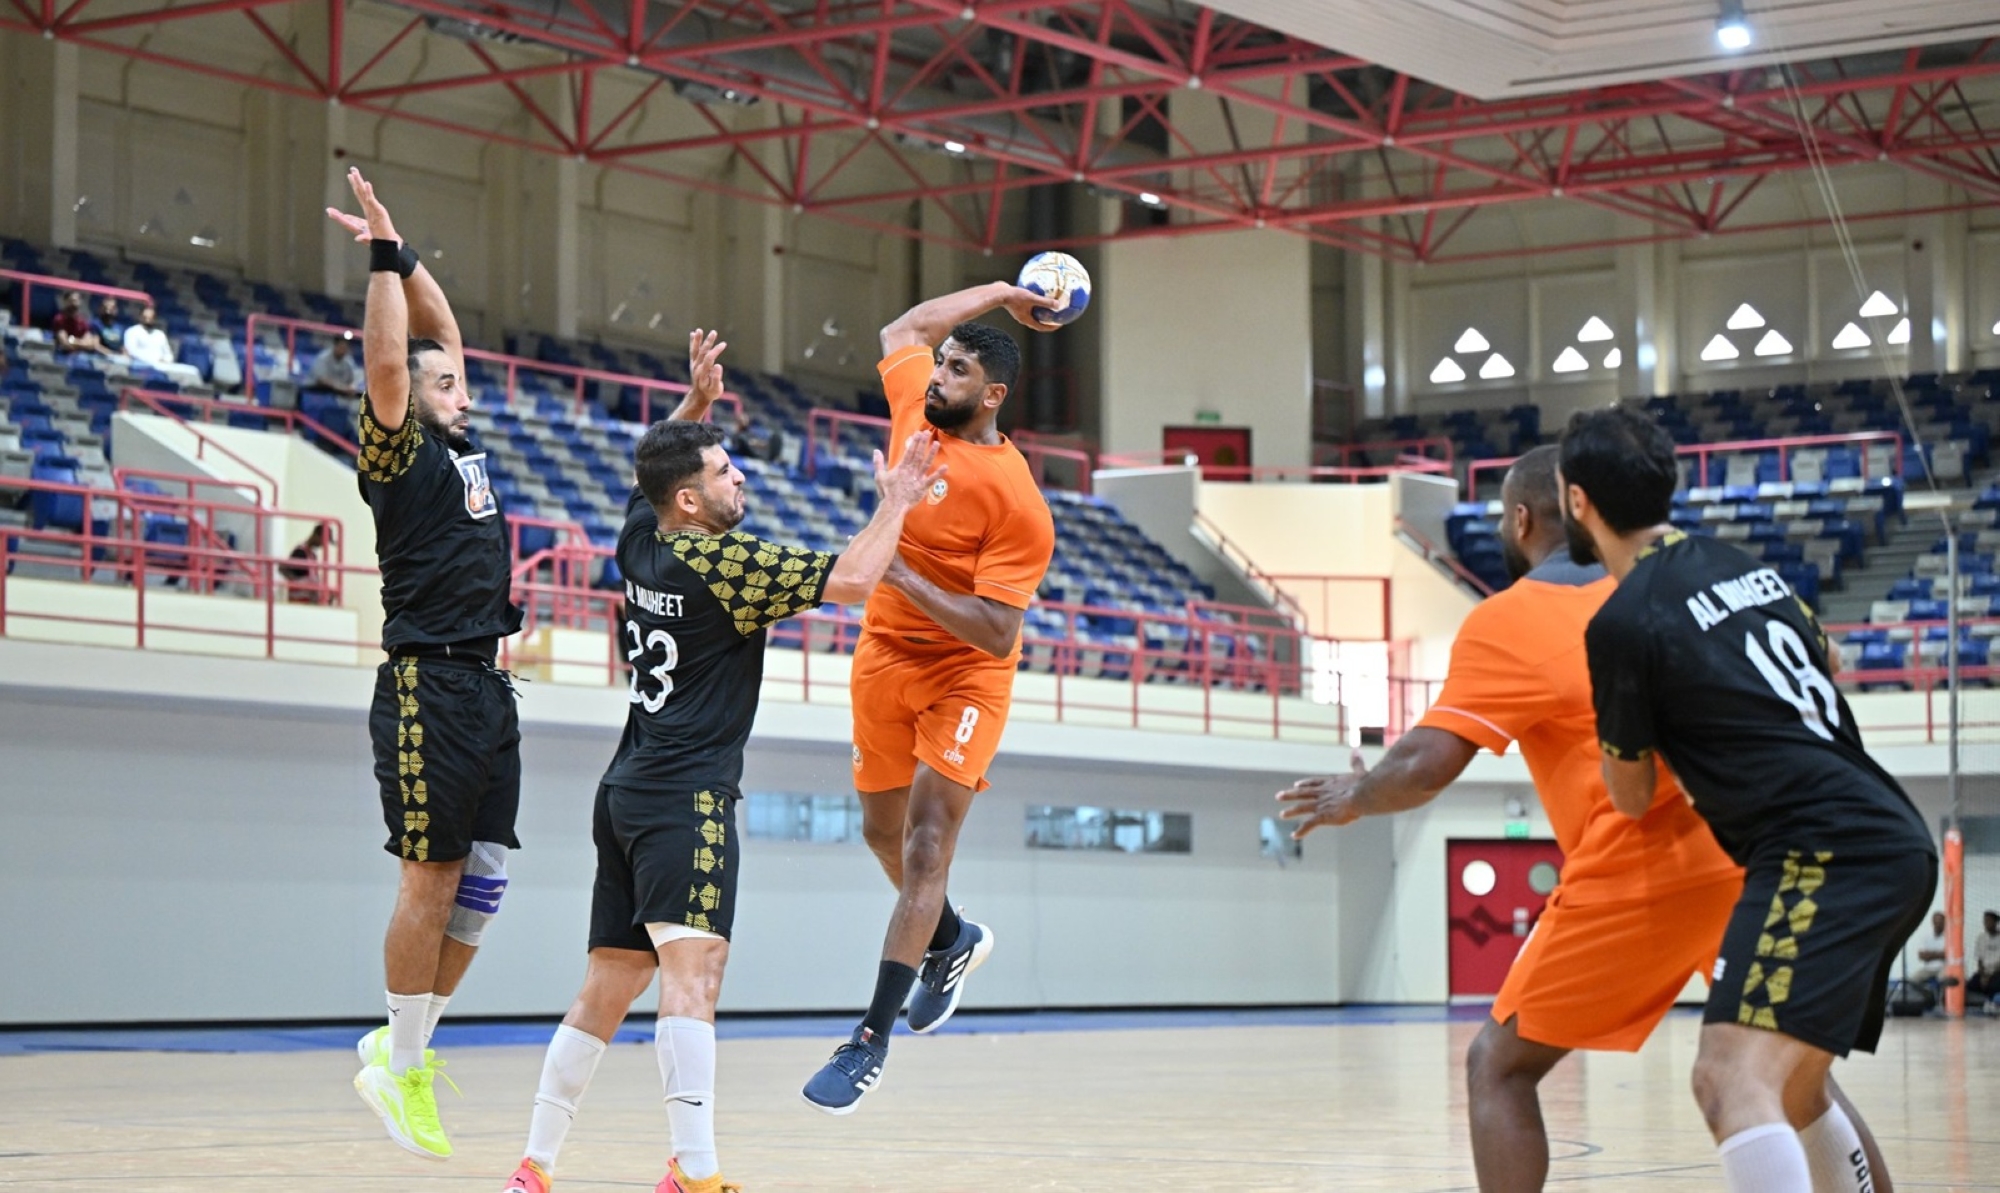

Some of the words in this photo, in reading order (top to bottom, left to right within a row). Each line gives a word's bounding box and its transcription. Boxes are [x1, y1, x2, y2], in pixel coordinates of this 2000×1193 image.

[1686, 590, 1730, 632] AL
[1745, 620, 1840, 742] 18
[954, 705, 980, 744] 8
